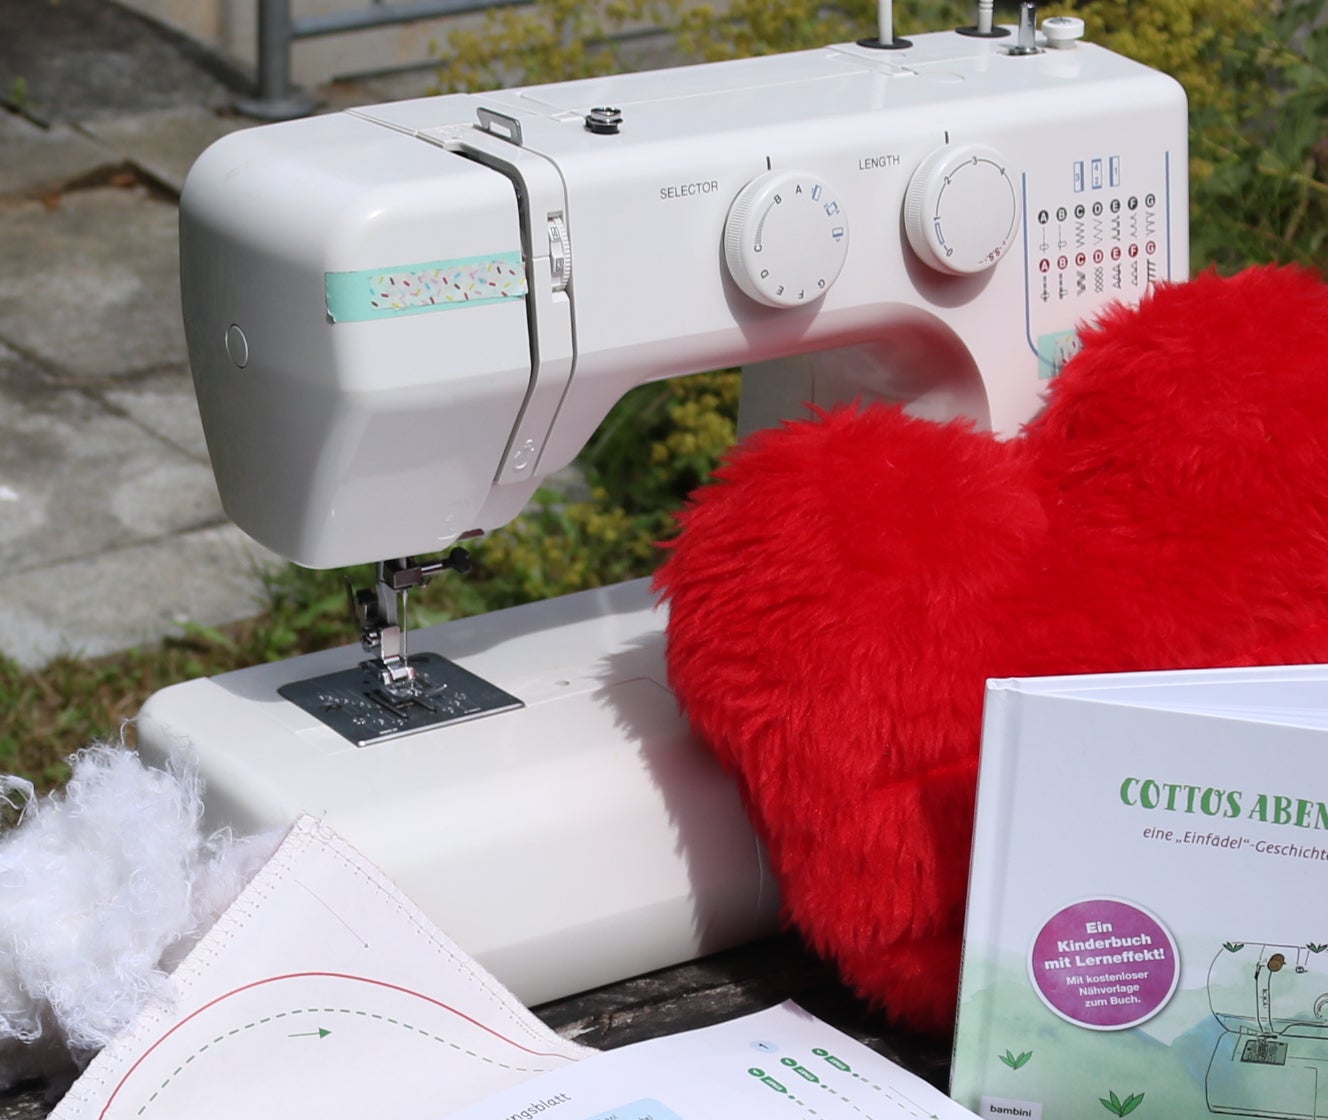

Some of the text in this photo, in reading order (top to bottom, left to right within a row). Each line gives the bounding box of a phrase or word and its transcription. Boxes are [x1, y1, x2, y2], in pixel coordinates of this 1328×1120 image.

[858, 154, 901, 171] LENGTH
[972, 156, 978, 166] 3
[660, 180, 719, 200] SELECTOR
[795, 184, 803, 194] A
[773, 194, 782, 204] B
[754, 244, 762, 253] C
[760, 269, 770, 280] D
[776, 285, 785, 296] E
[798, 289, 804, 300] F
[1120, 777, 1243, 819] COTTOS
[1143, 826, 1174, 841] eine
[1085, 921, 1113, 934] Ein
[1057, 933, 1152, 953] Kinderbuch
[1044, 948, 1166, 970] mit Lerneffekt!
[1066, 970, 1149, 986] Mit kostenloser
[1078, 983, 1140, 996] Nähvorlage
[1085, 995, 1141, 1008] zum Buch.
[989, 1104, 1032, 1117] bambini
